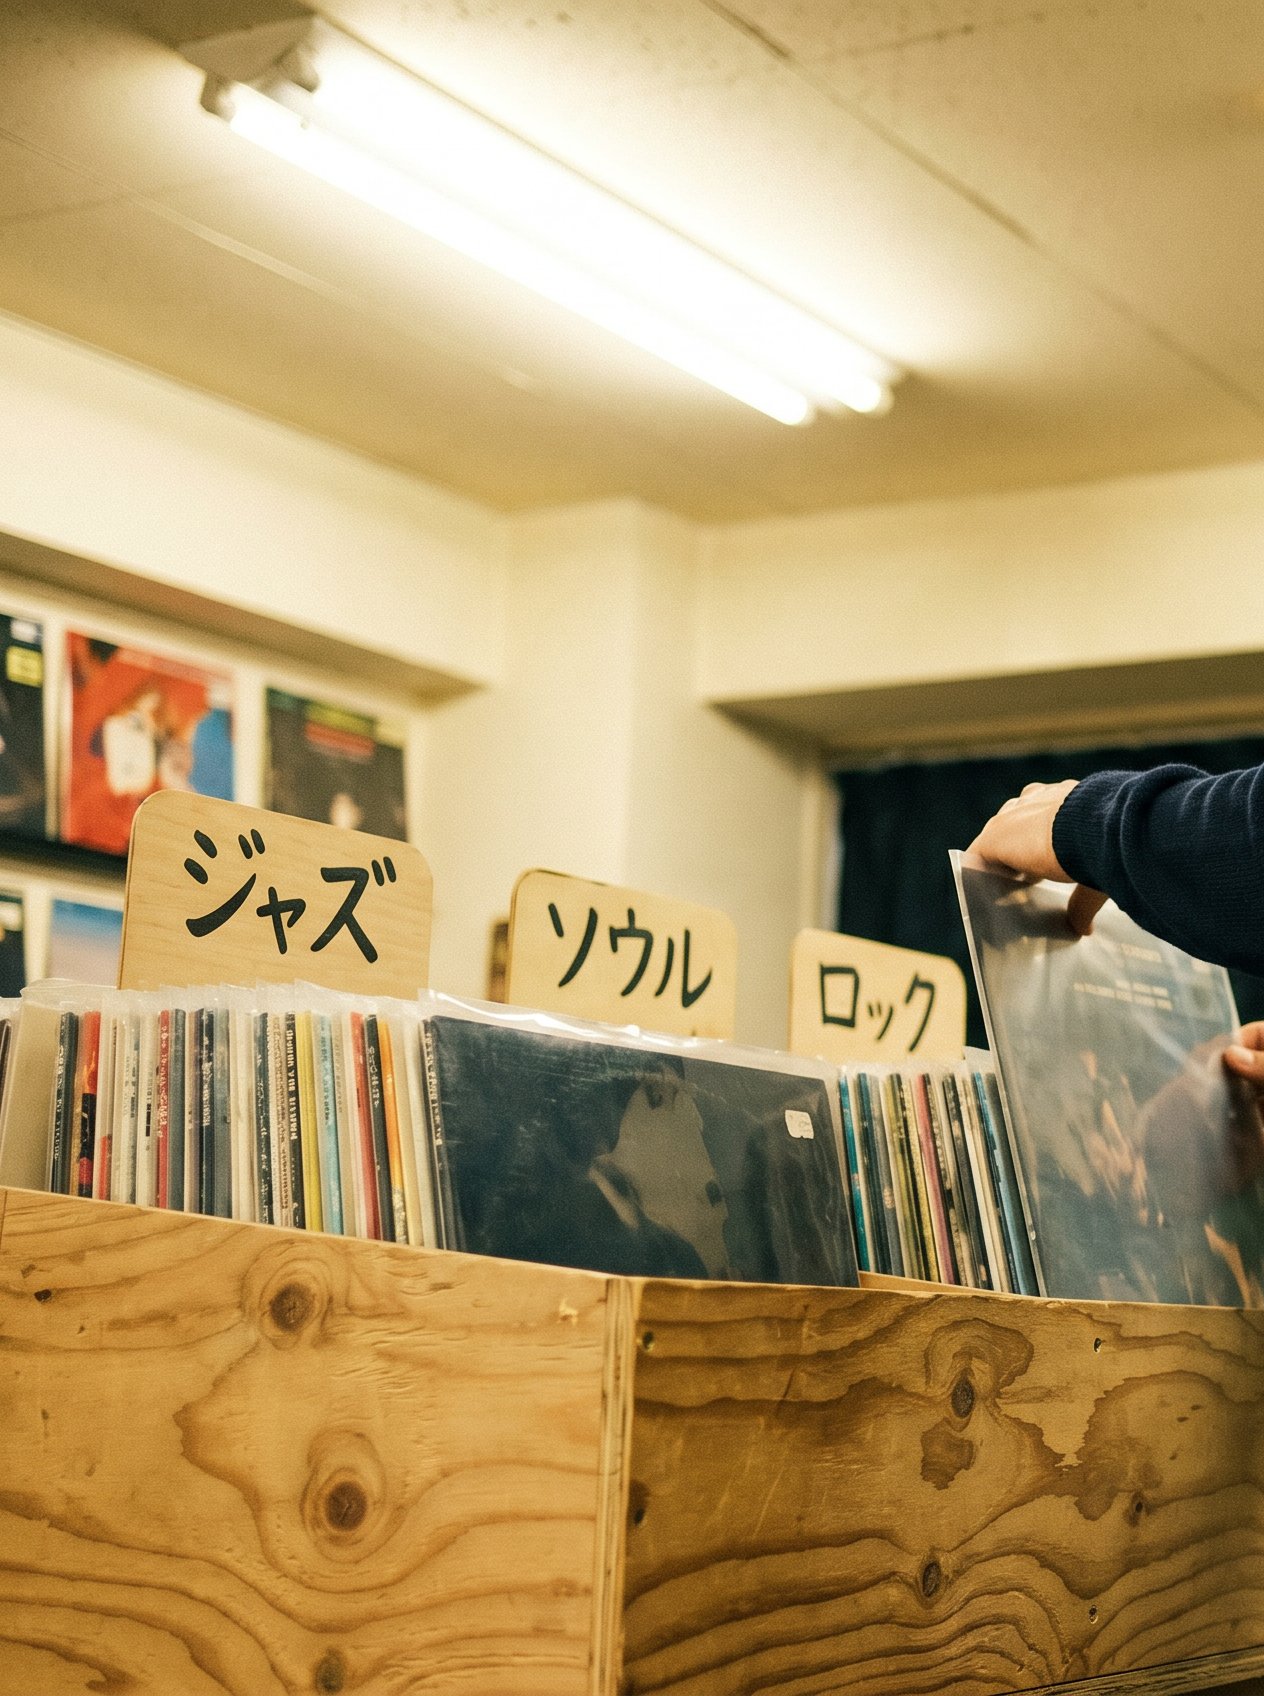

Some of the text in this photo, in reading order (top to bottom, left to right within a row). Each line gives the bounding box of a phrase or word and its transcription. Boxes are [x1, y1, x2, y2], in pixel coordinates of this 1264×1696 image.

[184, 828, 397, 964] ジャズ
[547, 902, 713, 1009] ソウル
[818, 961, 937, 1053] ロック
